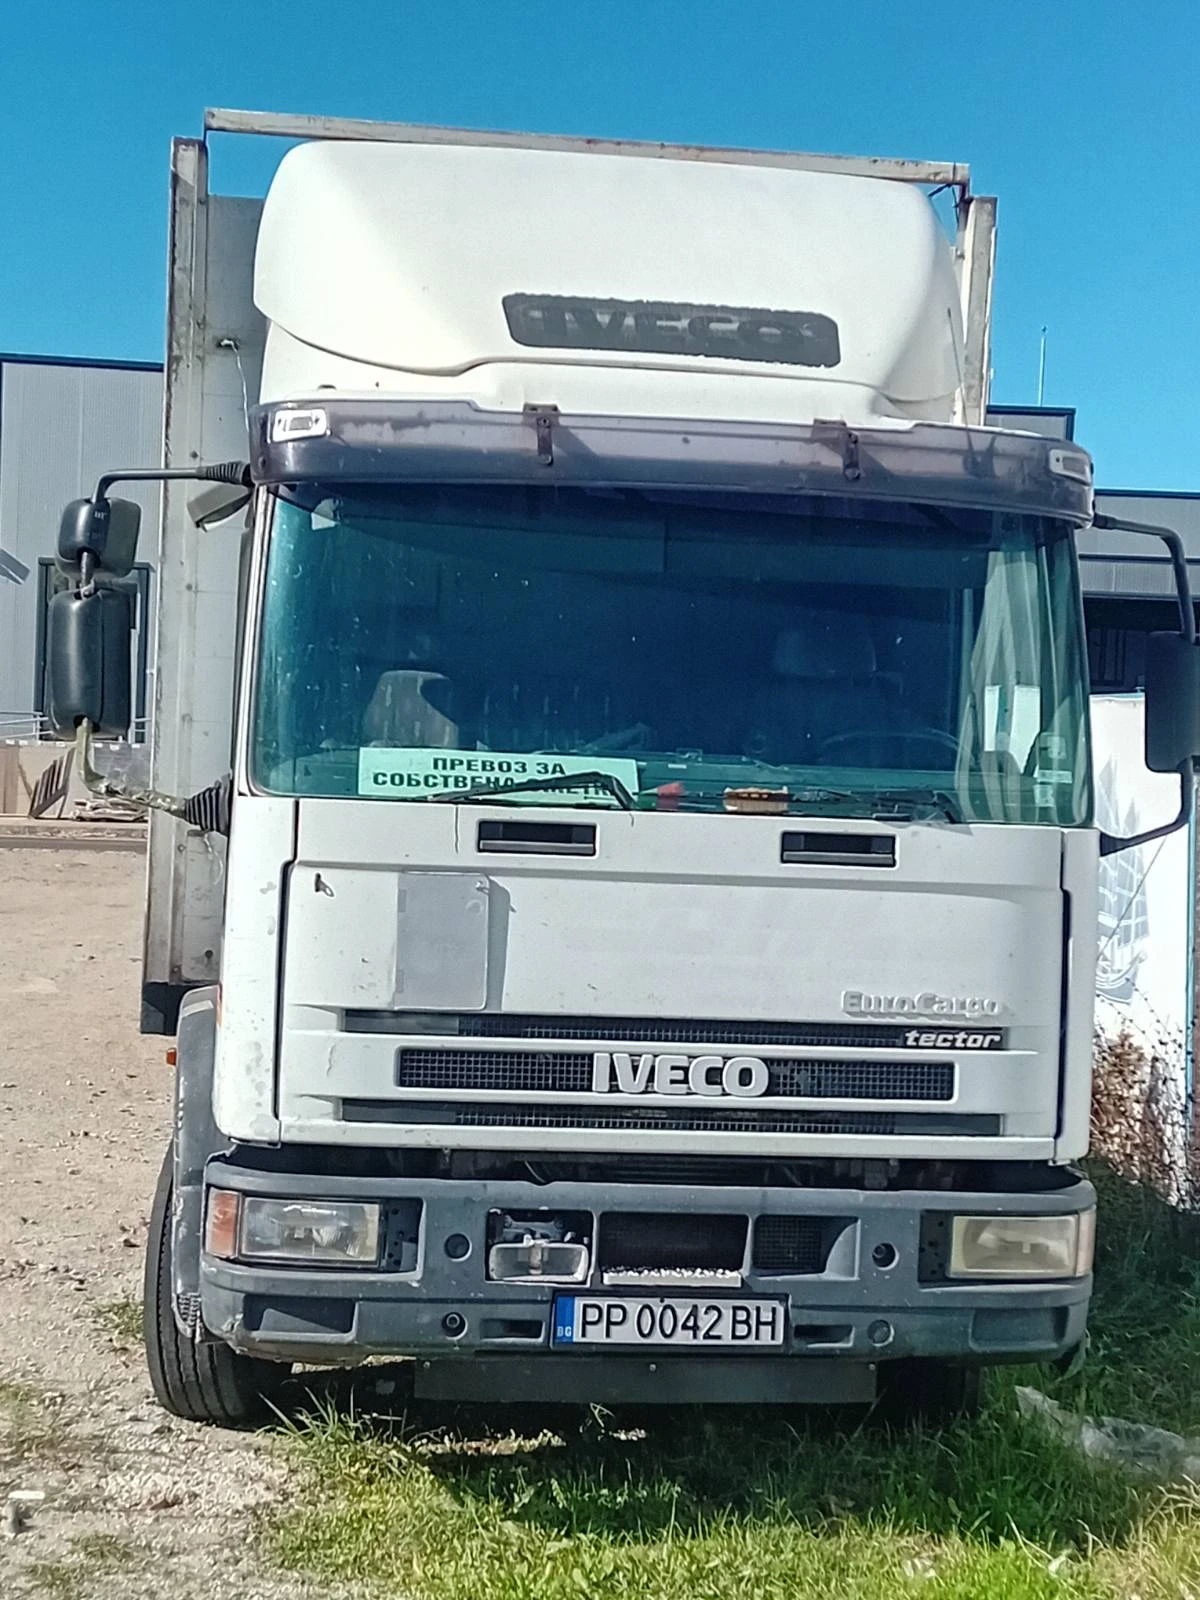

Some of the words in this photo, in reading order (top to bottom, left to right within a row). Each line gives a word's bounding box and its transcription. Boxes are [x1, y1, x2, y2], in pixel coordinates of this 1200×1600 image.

[432, 757, 528, 774] ПРЕВОЗ
[536, 762, 567, 776] ЗА
[840, 989, 1000, 1019] EuroCargo
[904, 1030, 1001, 1048] tector
[592, 1052, 769, 1097] IVECO
[556, 1325, 572, 1338] BG
[580, 1303, 628, 1339] PP
[635, 1303, 723, 1341] 0042
[730, 1304, 777, 1342] BH
